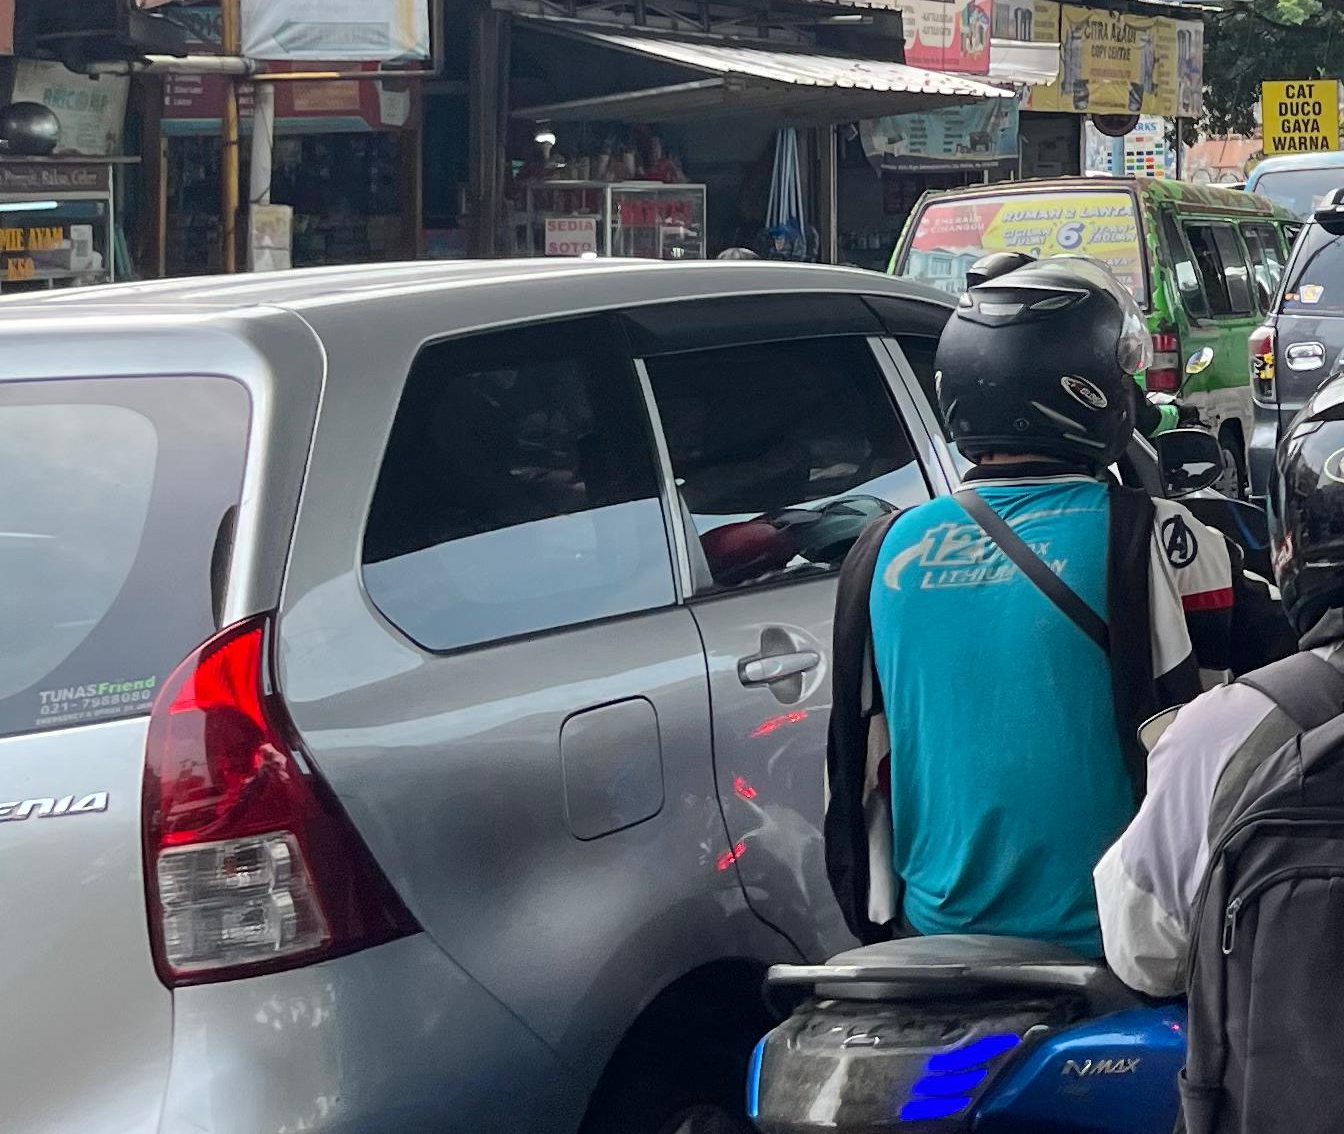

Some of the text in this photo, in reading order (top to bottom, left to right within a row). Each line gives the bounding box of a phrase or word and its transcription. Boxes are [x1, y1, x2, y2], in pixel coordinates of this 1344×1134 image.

[1285, 83, 1315, 99] CAT
[1278, 101, 1322, 117] DUCO
[1281, 118, 1321, 134] GAYA
[1272, 135, 1330, 152] WARNA
[547, 220, 593, 232] SEDIA
[1056, 221, 1086, 250] 6
[549, 241, 593, 254] SOTO
